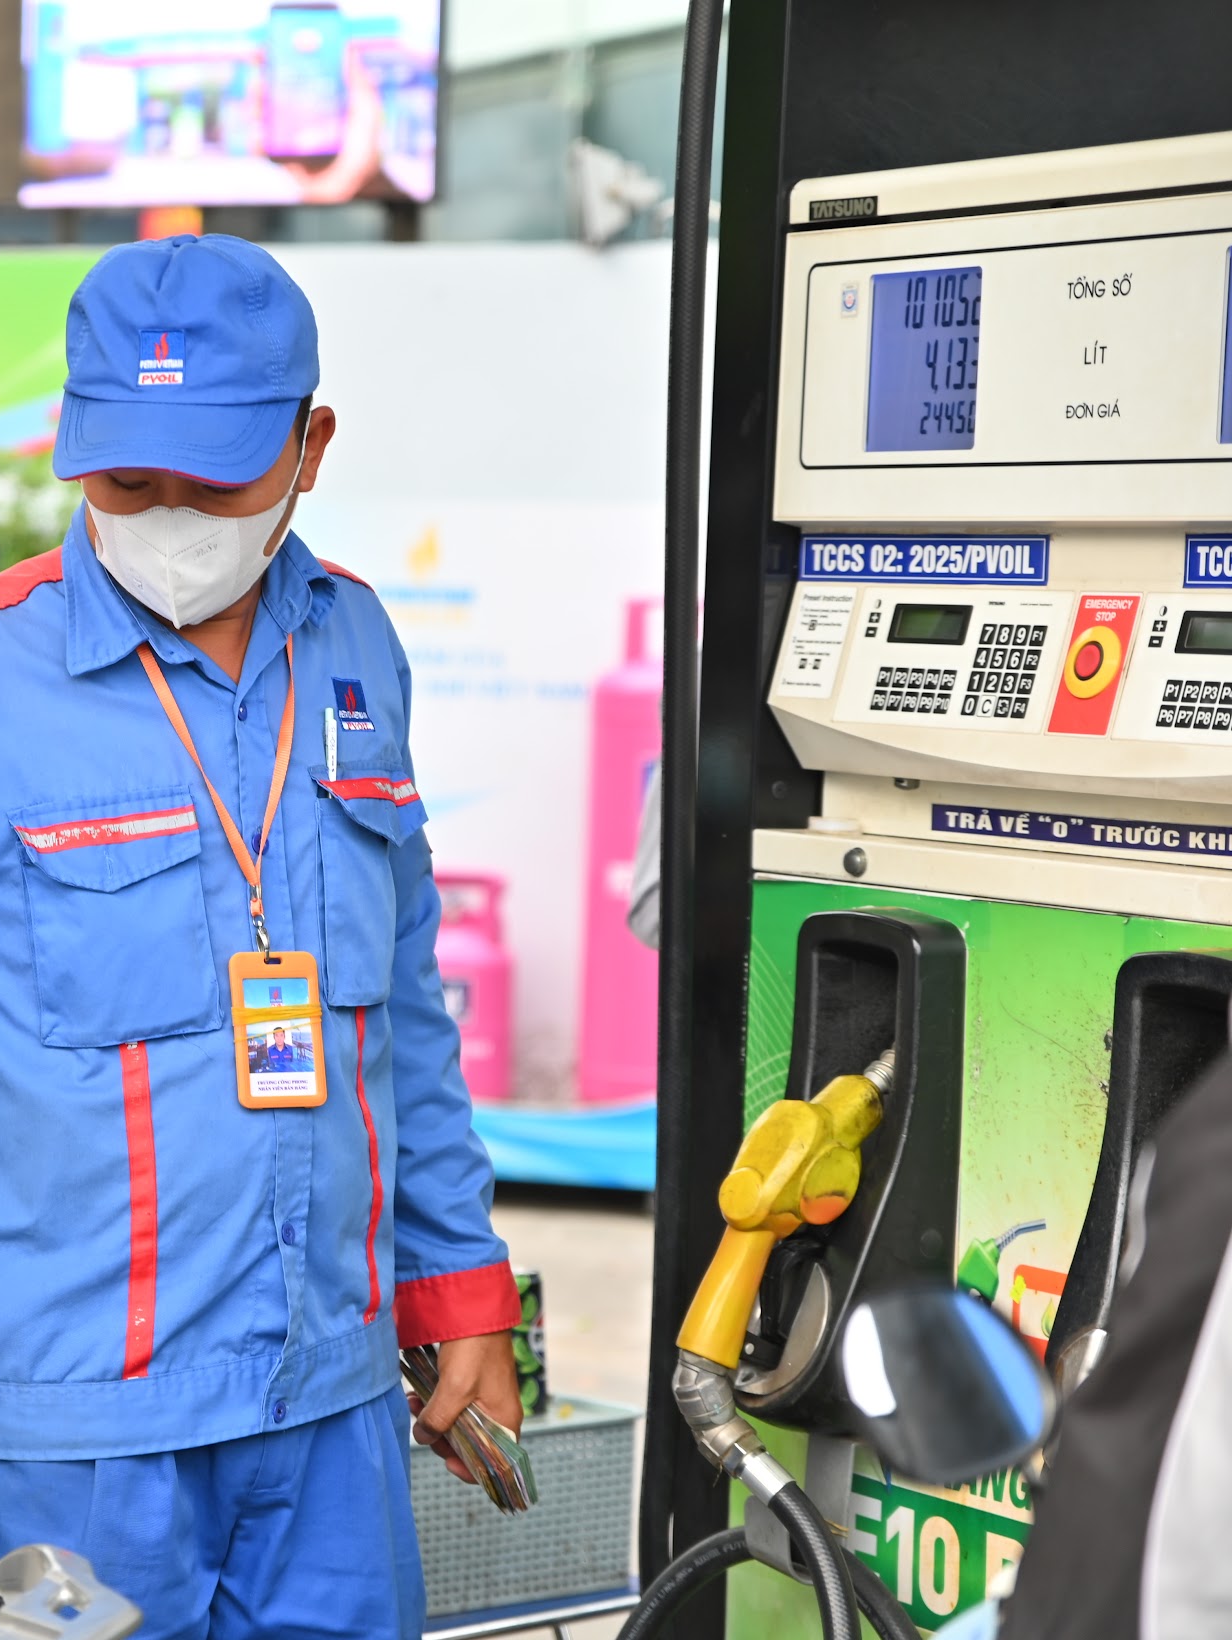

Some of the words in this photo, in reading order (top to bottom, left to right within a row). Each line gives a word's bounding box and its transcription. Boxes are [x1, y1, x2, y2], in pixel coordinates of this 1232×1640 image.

[811, 197, 875, 219] TATSUNO
[1067, 276, 1106, 299] TỔNG
[1112, 273, 1133, 297] SỐ
[1083, 340, 1107, 365] LÍT
[141, 374, 179, 384] PVOIL
[1065, 403, 1094, 419] ĐƠN
[1097, 399, 1121, 418] GIÁ
[811, 543, 865, 573] TCCS
[870, 544, 903, 573] 02:
[908, 544, 1035, 575] 2025/PVOIL
[1084, 598, 1134, 610] EMERGENCY
[1094, 611, 1117, 622] STOP
[982, 626, 995, 642] 7
[1000, 626, 1010, 643] 8
[1016, 627, 1027, 644] 9
[1032, 630, 1044, 642] F1
[976, 651, 987, 666] 4
[993, 651, 1004, 667] 5
[1009, 651, 1021, 668] 6
[1026, 654, 1038, 666] F2
[878, 671, 890, 684] P1
[894, 672, 907, 684] P2
[910, 672, 922, 685] P3
[925, 673, 938, 686] P4
[941, 673, 954, 687] P5
[986, 675, 998, 691] 2
[1003, 675, 1014, 692] 3
[1020, 678, 1032, 690] F3
[1164, 685, 1179, 698] P1
[1183, 685, 1199, 698] P2
[1202, 686, 1218, 700] P3
[872, 694, 885, 706] P6
[888, 695, 901, 707] P7
[904, 696, 917, 708] P8
[920, 697, 933, 709] P9
[935, 697, 949, 710] P10
[981, 699, 993, 714] C
[1014, 702, 1026, 714] F4
[1158, 709, 1173, 723] P6
[1177, 710, 1193, 724] P7
[1195, 711, 1211, 725] P8
[1214, 712, 1230, 726] P9
[944, 809, 993, 832] TRẢ
[999, 812, 1030, 835] VỀ
[1090, 823, 1180, 849] TRƯỚC
[847, 1490, 961, 1617] E10
